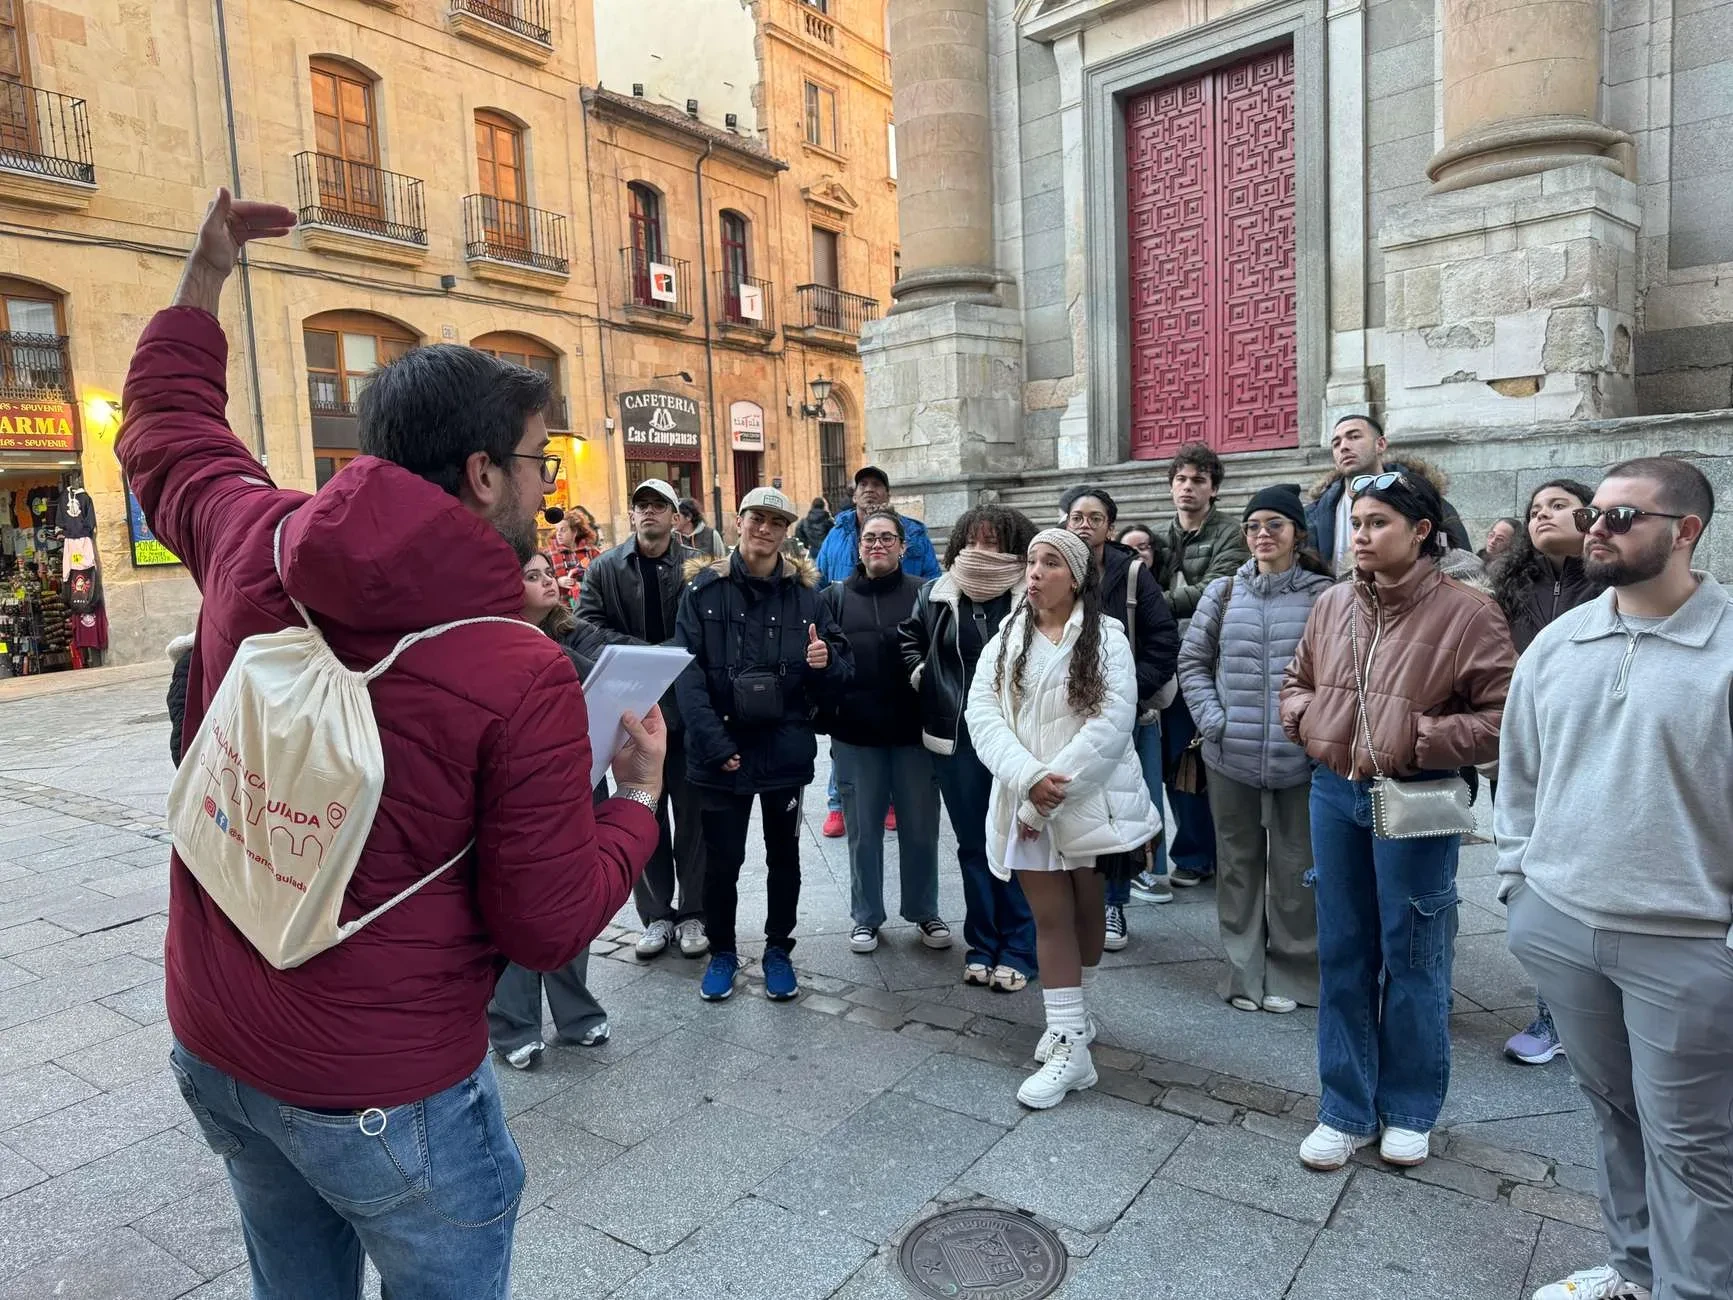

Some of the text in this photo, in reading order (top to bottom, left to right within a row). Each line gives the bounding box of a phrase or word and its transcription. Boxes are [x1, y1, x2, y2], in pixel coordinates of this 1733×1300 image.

[625, 394, 696, 415] CAFETERIA
[627, 425, 698, 446] Las Campanas
[267, 800, 321, 829] UIADA
